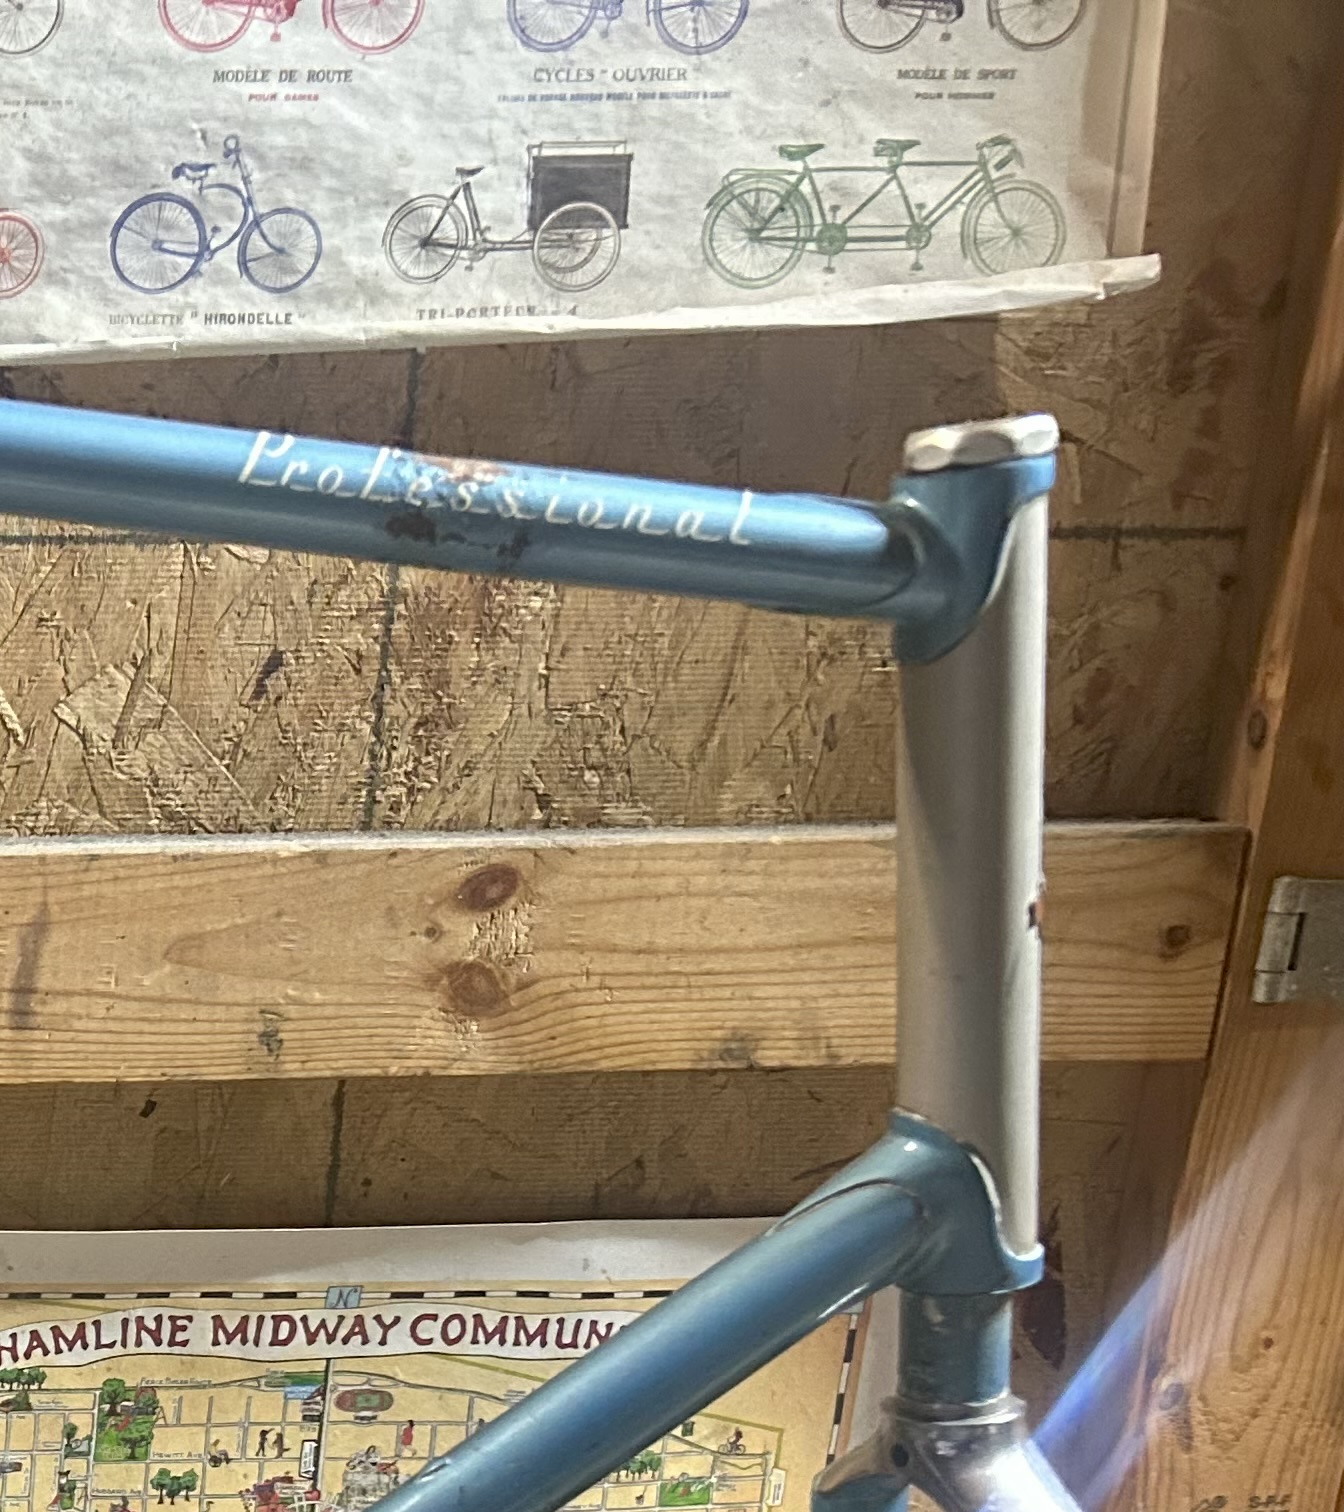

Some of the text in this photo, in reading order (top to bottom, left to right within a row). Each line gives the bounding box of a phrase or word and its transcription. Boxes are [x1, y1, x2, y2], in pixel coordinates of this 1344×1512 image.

[213, 66, 353, 83] MODÈLE DE ROUTE
[533, 68, 594, 82] CYCLES
[211, 1314, 402, 1347] MIDWAY
[409, 1313, 628, 1350] COMMUN
